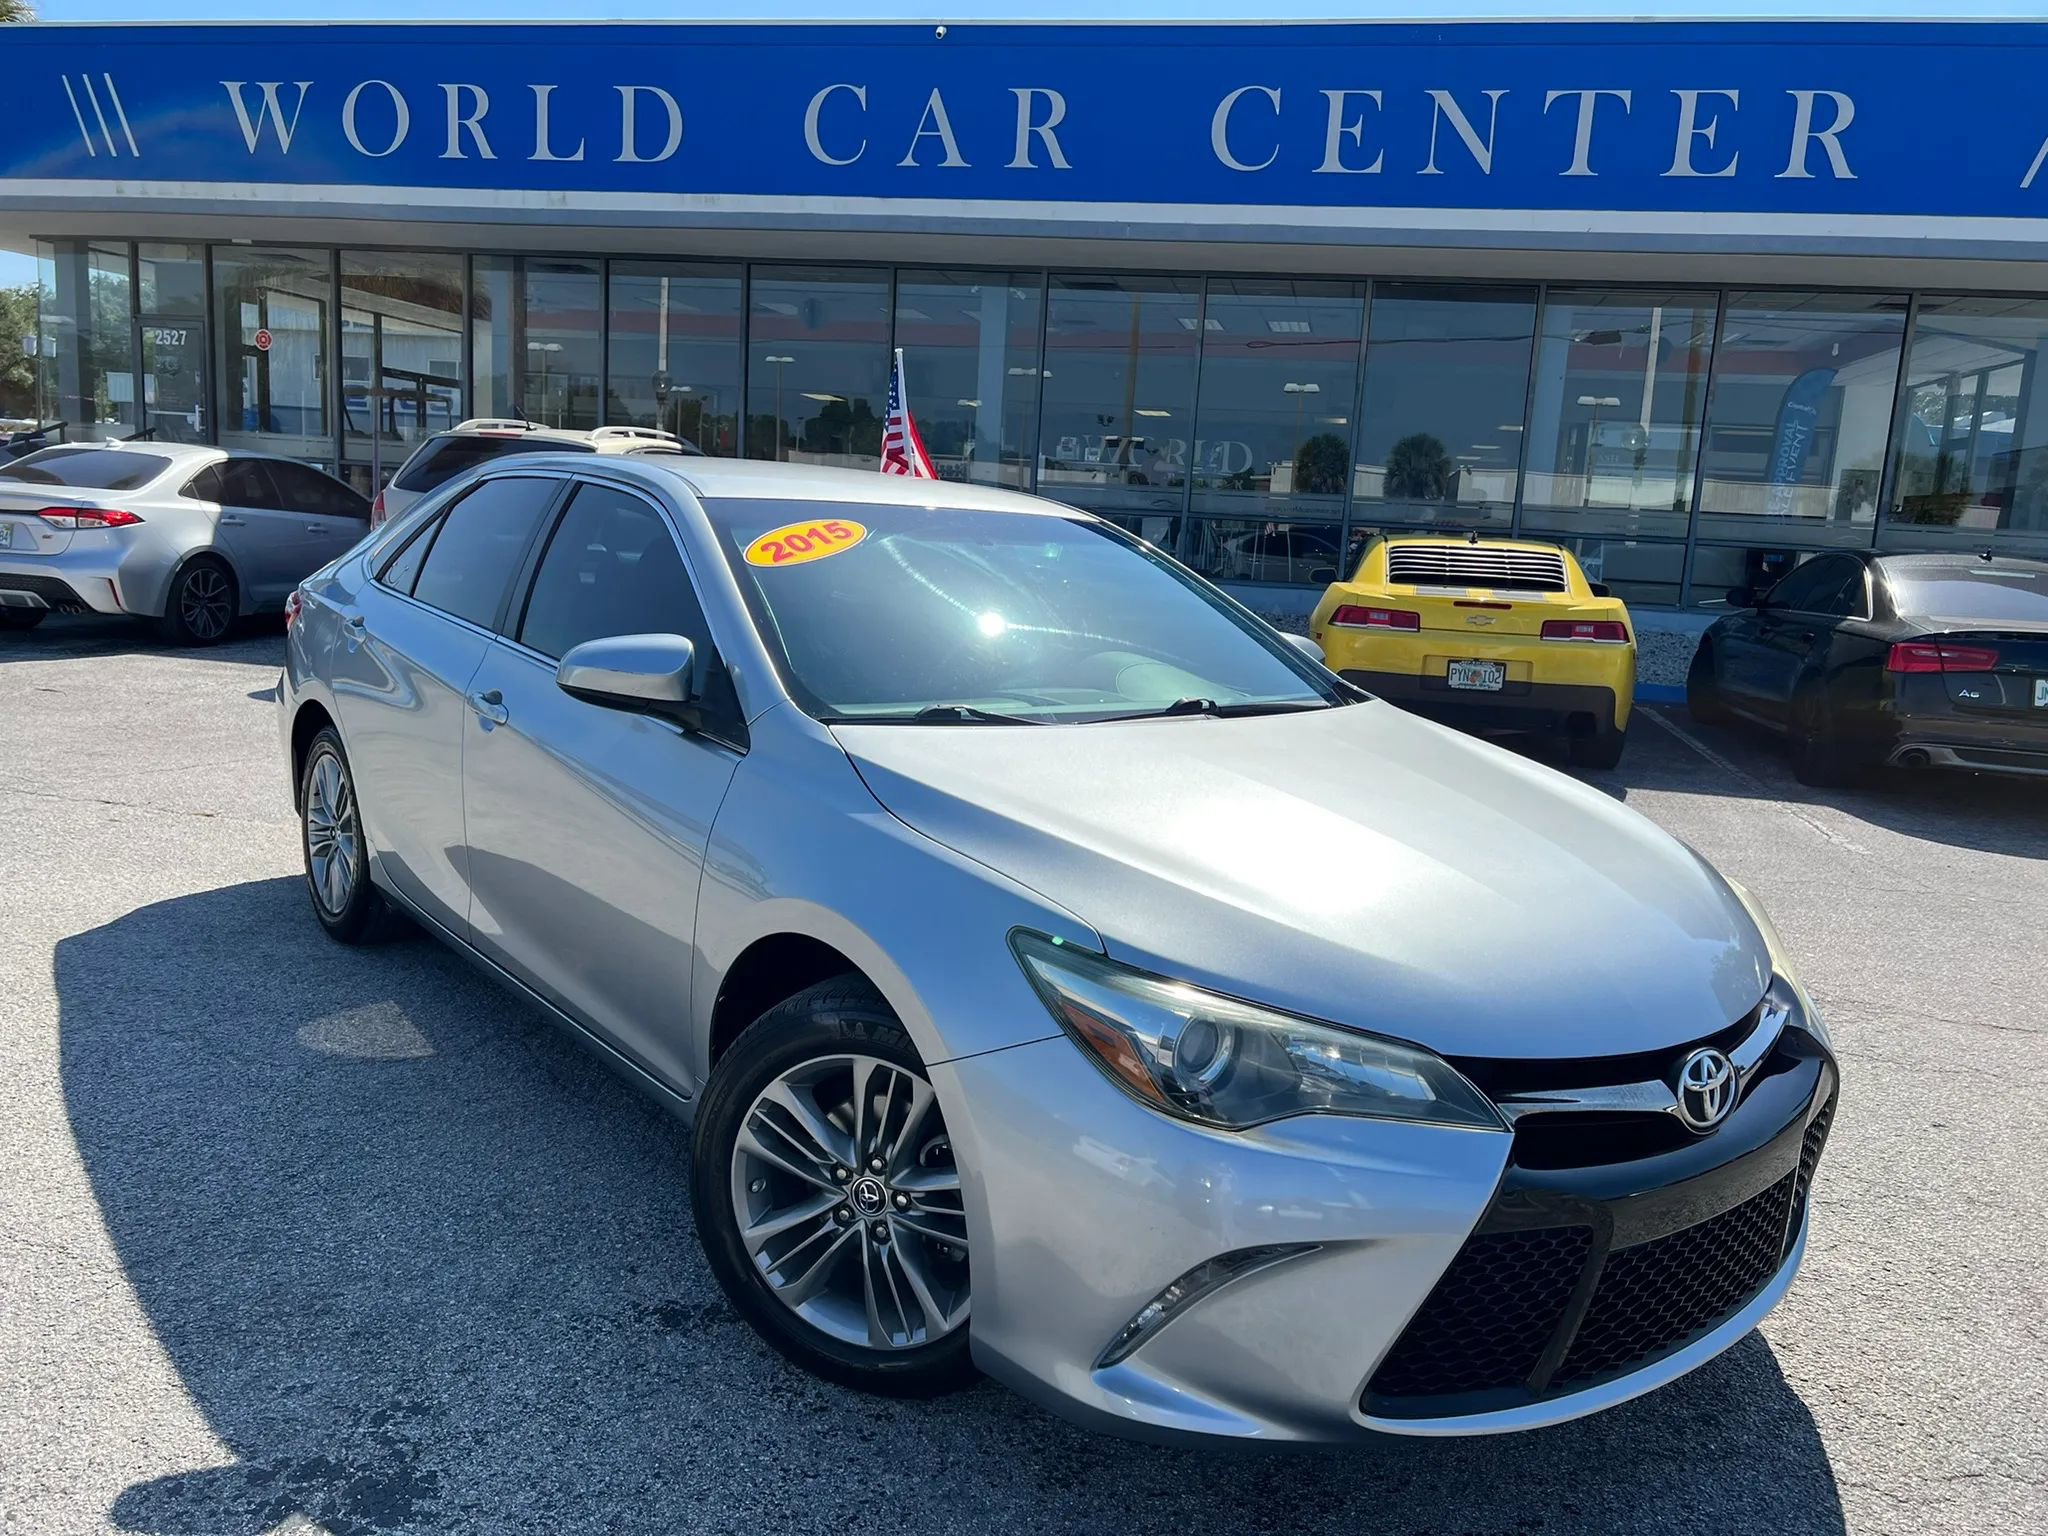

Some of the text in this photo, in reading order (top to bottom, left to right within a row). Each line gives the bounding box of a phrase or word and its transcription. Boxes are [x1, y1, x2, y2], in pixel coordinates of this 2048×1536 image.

[220, 81, 1858, 178] WORLD CAR CENTER
[155, 330, 187, 345] 2527
[760, 521, 854, 563] 2015
[1450, 667, 1470, 682] PYN
[1958, 689, 1980, 698] A6
